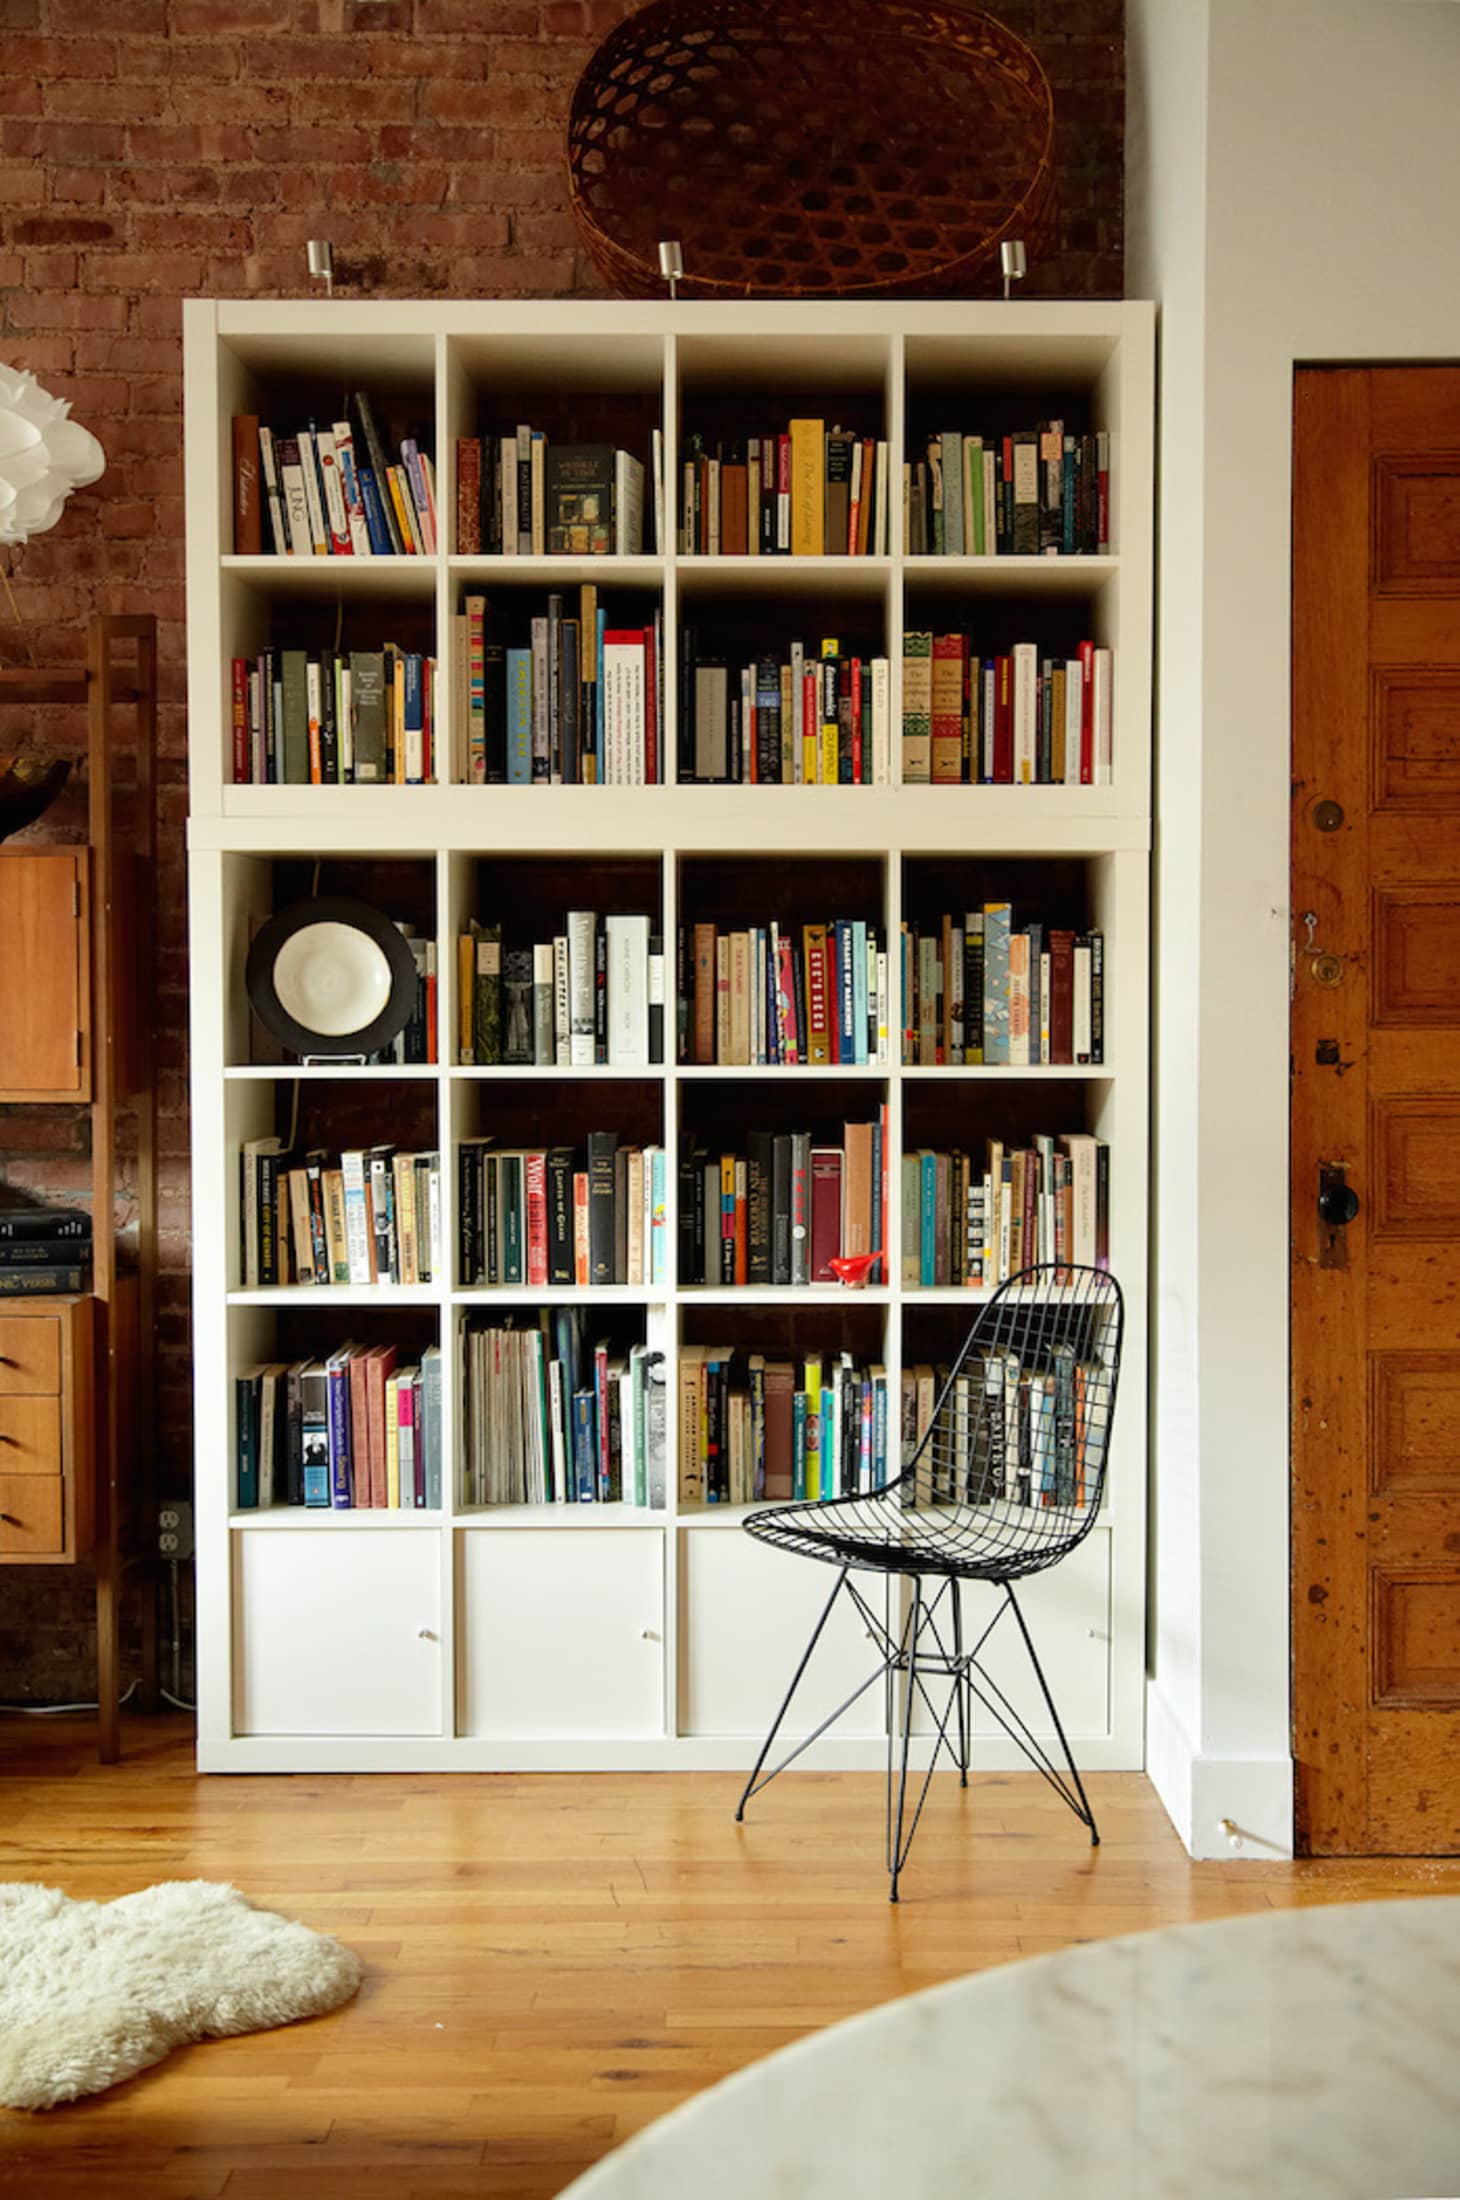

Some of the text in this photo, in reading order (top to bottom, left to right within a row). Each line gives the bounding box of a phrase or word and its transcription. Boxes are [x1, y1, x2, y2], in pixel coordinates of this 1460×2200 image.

[804, 462, 814, 480] The
[287, 486, 305, 522] JUNG
[520, 464, 529, 529] MATERIALITY
[804, 485, 814, 498] Art
[517, 660, 527, 757] AMERICAN ELF
[825, 665, 836, 717] Economics
[810, 952, 825, 1029] EVE'S SEED
[843, 928, 852, 1036] PASSAGE OF DARKNESS
[262, 1182, 270, 1204] DAVIS
[528, 1159, 543, 1195] Wolf
[262, 1205, 271, 1224] CITY
[750, 1161, 760, 1246] JOHN CHEEVER
[794, 1169, 806, 1225] MAUS
[335, 1379, 343, 1395] New
[335, 1397, 344, 1426] Complete
[336, 1427, 345, 1446] Guide
[991, 1412, 1005, 1488] BALTHUS
[336, 1455, 347, 1488] Sewing
